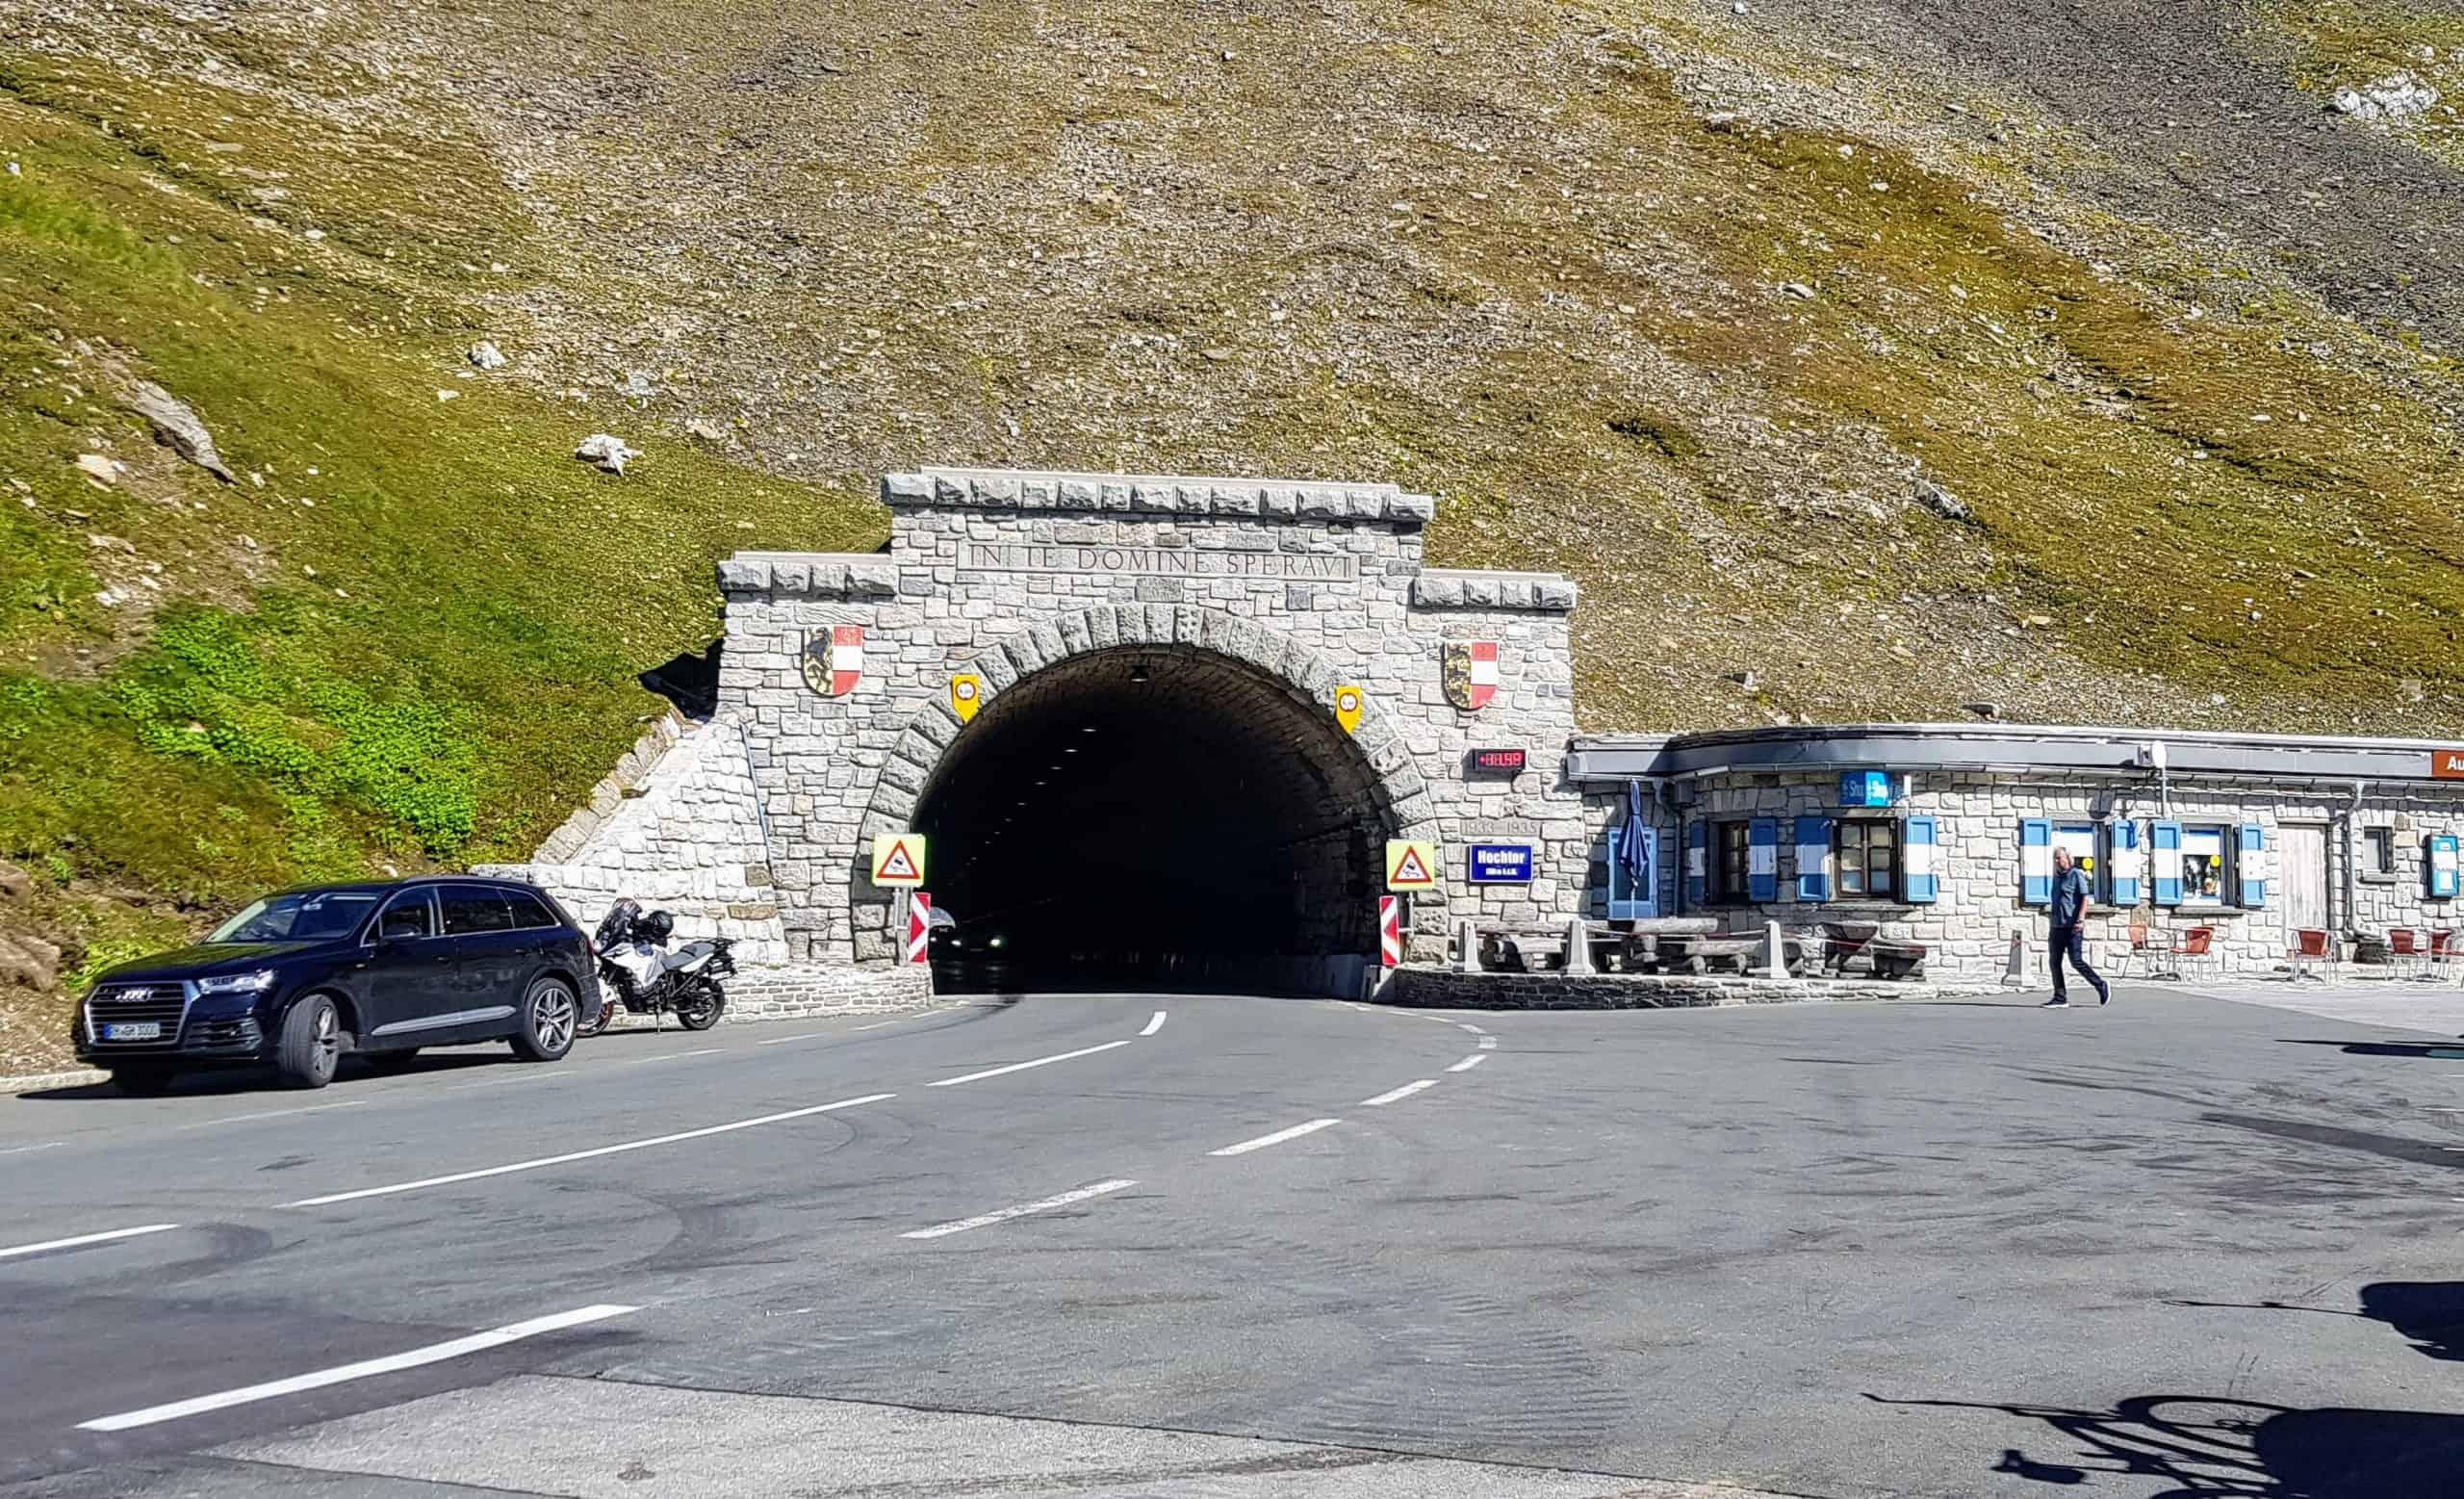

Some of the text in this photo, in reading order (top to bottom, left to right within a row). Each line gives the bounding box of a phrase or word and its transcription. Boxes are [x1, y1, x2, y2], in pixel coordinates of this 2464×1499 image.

[970, 544, 1002, 567] IN
[1078, 548, 1209, 574] DOMINE
[1226, 553, 1349, 578] SPERAVI
[1477, 850, 1525, 864] Hochtor
